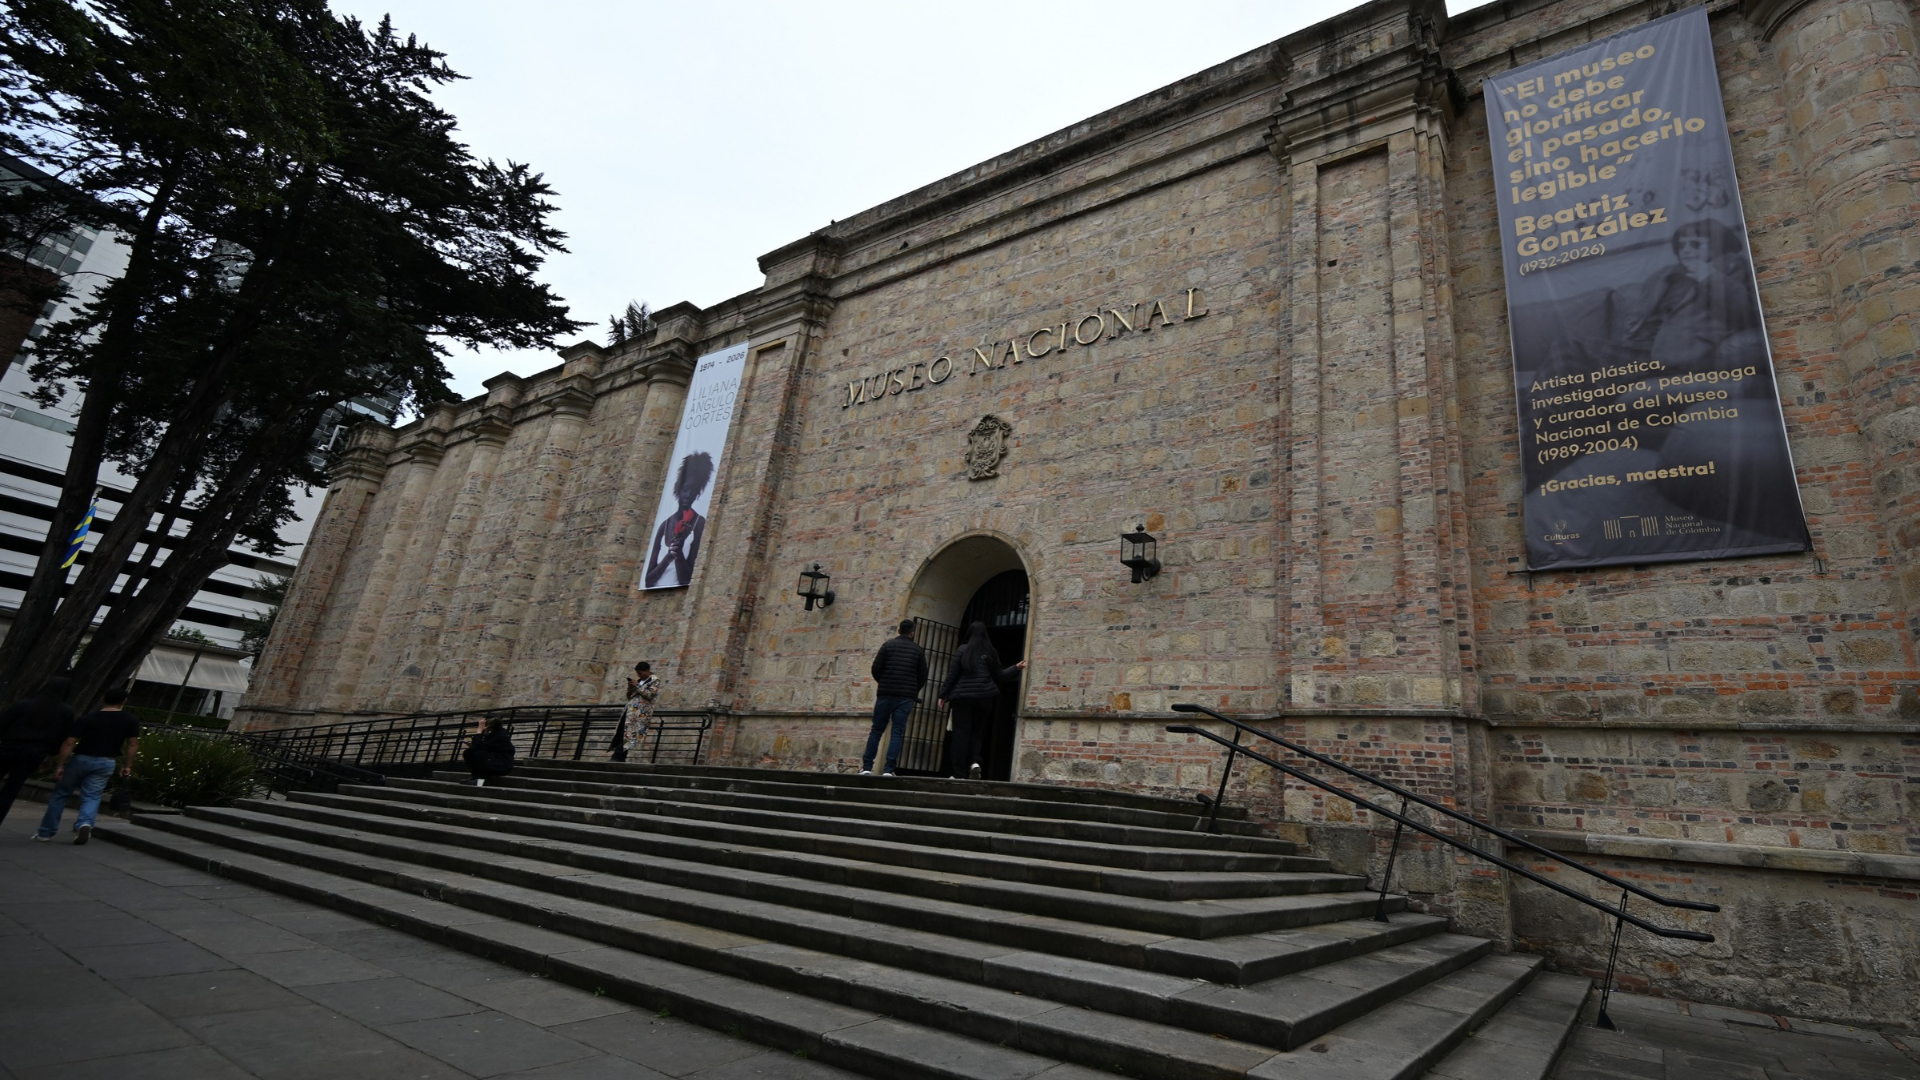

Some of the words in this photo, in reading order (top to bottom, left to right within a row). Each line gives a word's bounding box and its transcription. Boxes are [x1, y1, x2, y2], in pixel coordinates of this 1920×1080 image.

[1554, 44, 1656, 87] museo
[1503, 102, 1538, 124] no
[1547, 74, 1625, 109] debe
[1505, 89, 1645, 148] glorificar
[1507, 141, 1533, 163] el
[1542, 107, 1672, 158] pasado,
[1509, 156, 1571, 184] sino
[1580, 116, 1706, 163] hacerlo
[1511, 154, 1633, 205] legible”
[1514, 193, 1630, 237] Beatriz
[1516, 206, 1668, 257] González
[1519, 243, 1606, 277] (1932-2026)
[699, 361, 715, 372] 1974
[726, 351, 746, 363] 2026
[842, 356, 953, 409] MUSEO
[970, 287, 1209, 375] NACIONAL
[693, 378, 738, 401] LILIANA
[1530, 372, 1585, 393] Artista
[1590, 358, 1666, 383] plástica,
[1532, 379, 1652, 410] investigadora,
[1658, 364, 1757, 391] pedagoga
[1533, 416, 1543, 429] y
[1548, 401, 1626, 425] curadora
[1633, 390, 1660, 410] del
[1667, 388, 1728, 406] Museo
[1535, 420, 1611, 445] Nacional
[1617, 416, 1640, 431] de
[1645, 406, 1739, 428] Colombia
[1537, 436, 1639, 465] (1989-2004)
[1540, 474, 1621, 497] ¡Gracias,
[1626, 461, 1716, 483] maestra!
[1543, 532, 1581, 542] Culturas
[1665, 520, 1703, 529] Nacional
[1679, 526, 1721, 534] Colombia
